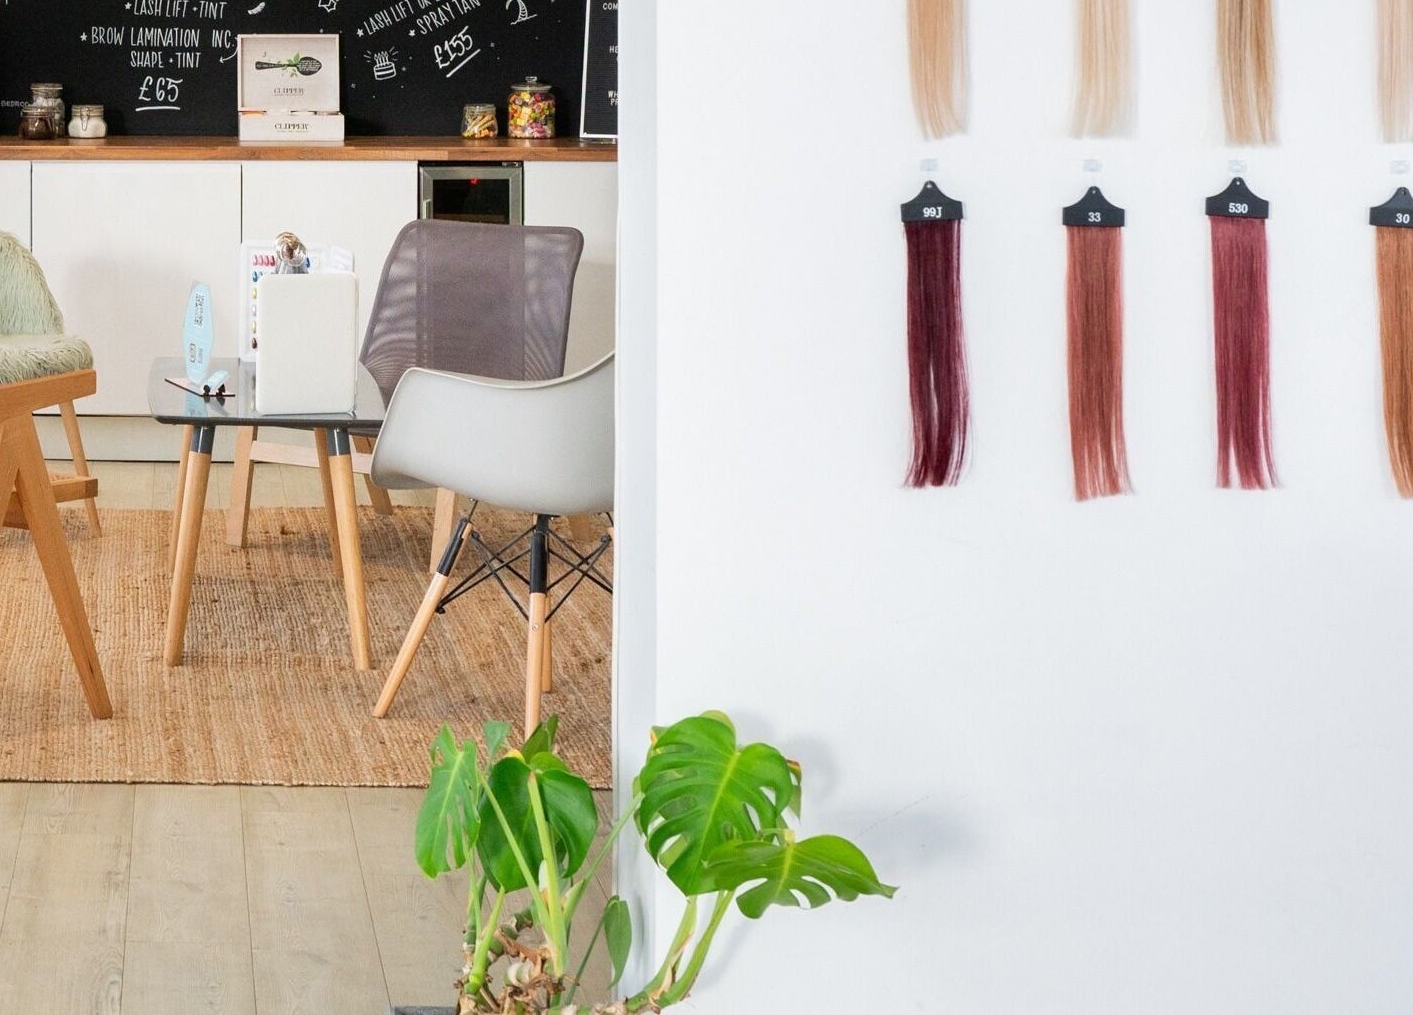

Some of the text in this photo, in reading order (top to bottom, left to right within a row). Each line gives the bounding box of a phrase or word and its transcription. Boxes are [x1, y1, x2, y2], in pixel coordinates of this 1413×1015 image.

[166, 0, 189, 18] LIFT
[198, 0, 227, 19] TINT
[416, 2, 455, 36] SPRAY
[363, 10, 393, 37] LASH
[91, 26, 125, 46] BROW
[130, 27, 199, 48] LAMINATION
[433, 26, 473, 70] £155
[130, 51, 164, 69] SHAPE
[175, 52, 202, 68] TINT
[137, 75, 184, 102] £65
[923, 206, 942, 219] 99J
[1088, 212, 1101, 223] 33
[1228, 203, 1249, 214] 530
[1395, 213, 1410, 224] 30
